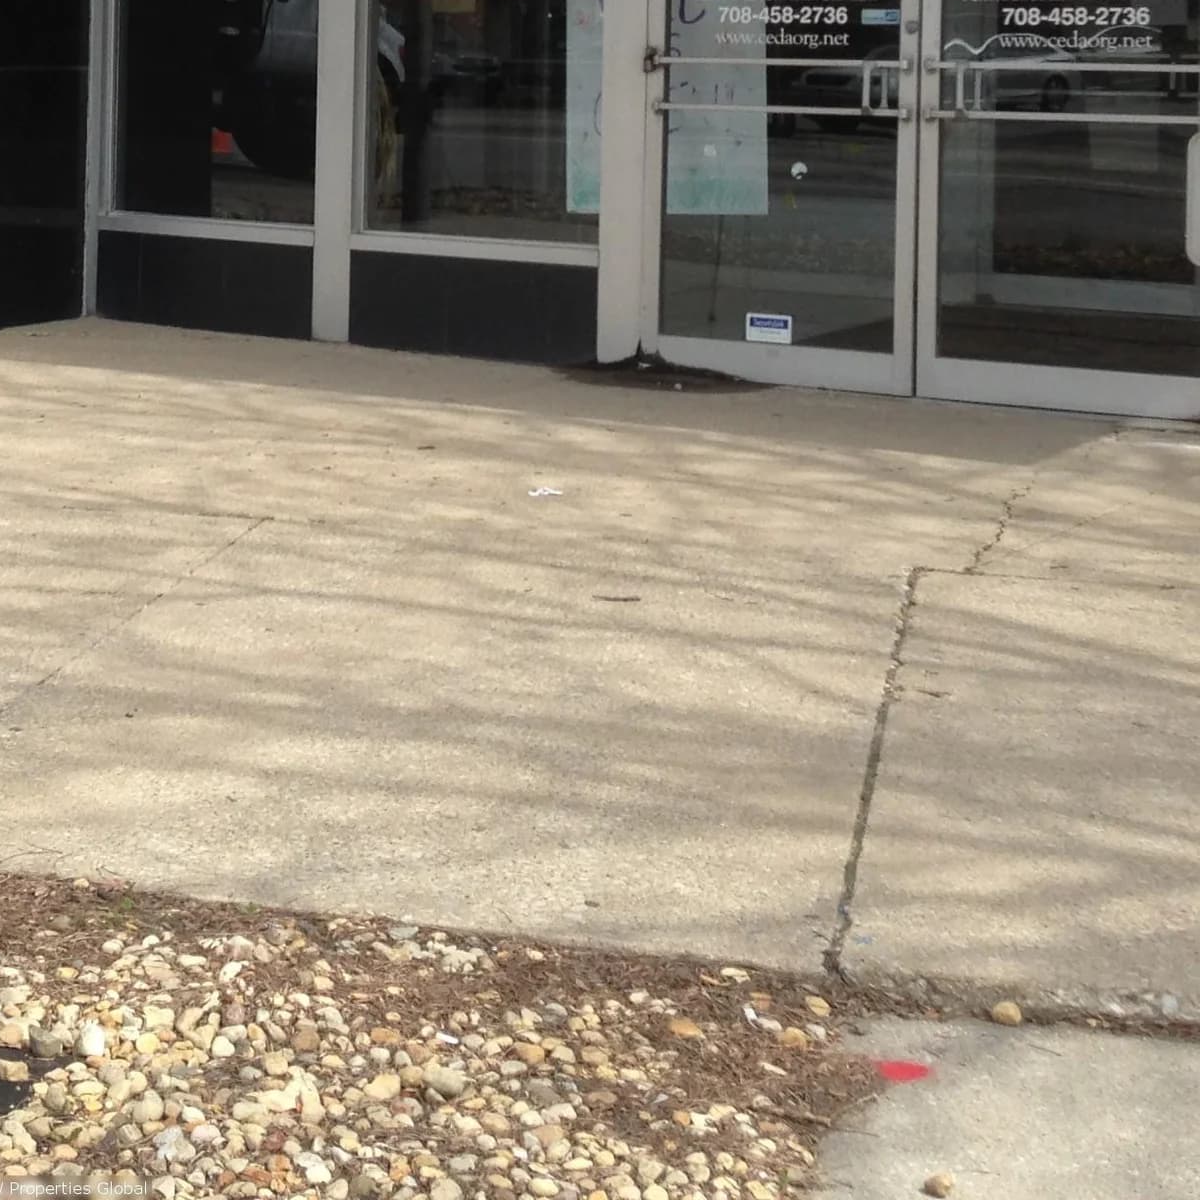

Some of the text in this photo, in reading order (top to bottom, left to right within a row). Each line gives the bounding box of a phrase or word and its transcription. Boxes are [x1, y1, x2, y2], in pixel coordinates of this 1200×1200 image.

[718, 6, 849, 24] 708-458-2736
[1002, 7, 1150, 26] 708-458-2736
[715, 28, 849, 49] www.cedaorg.net
[1000, 30, 1153, 51] www.cedaorg.net
